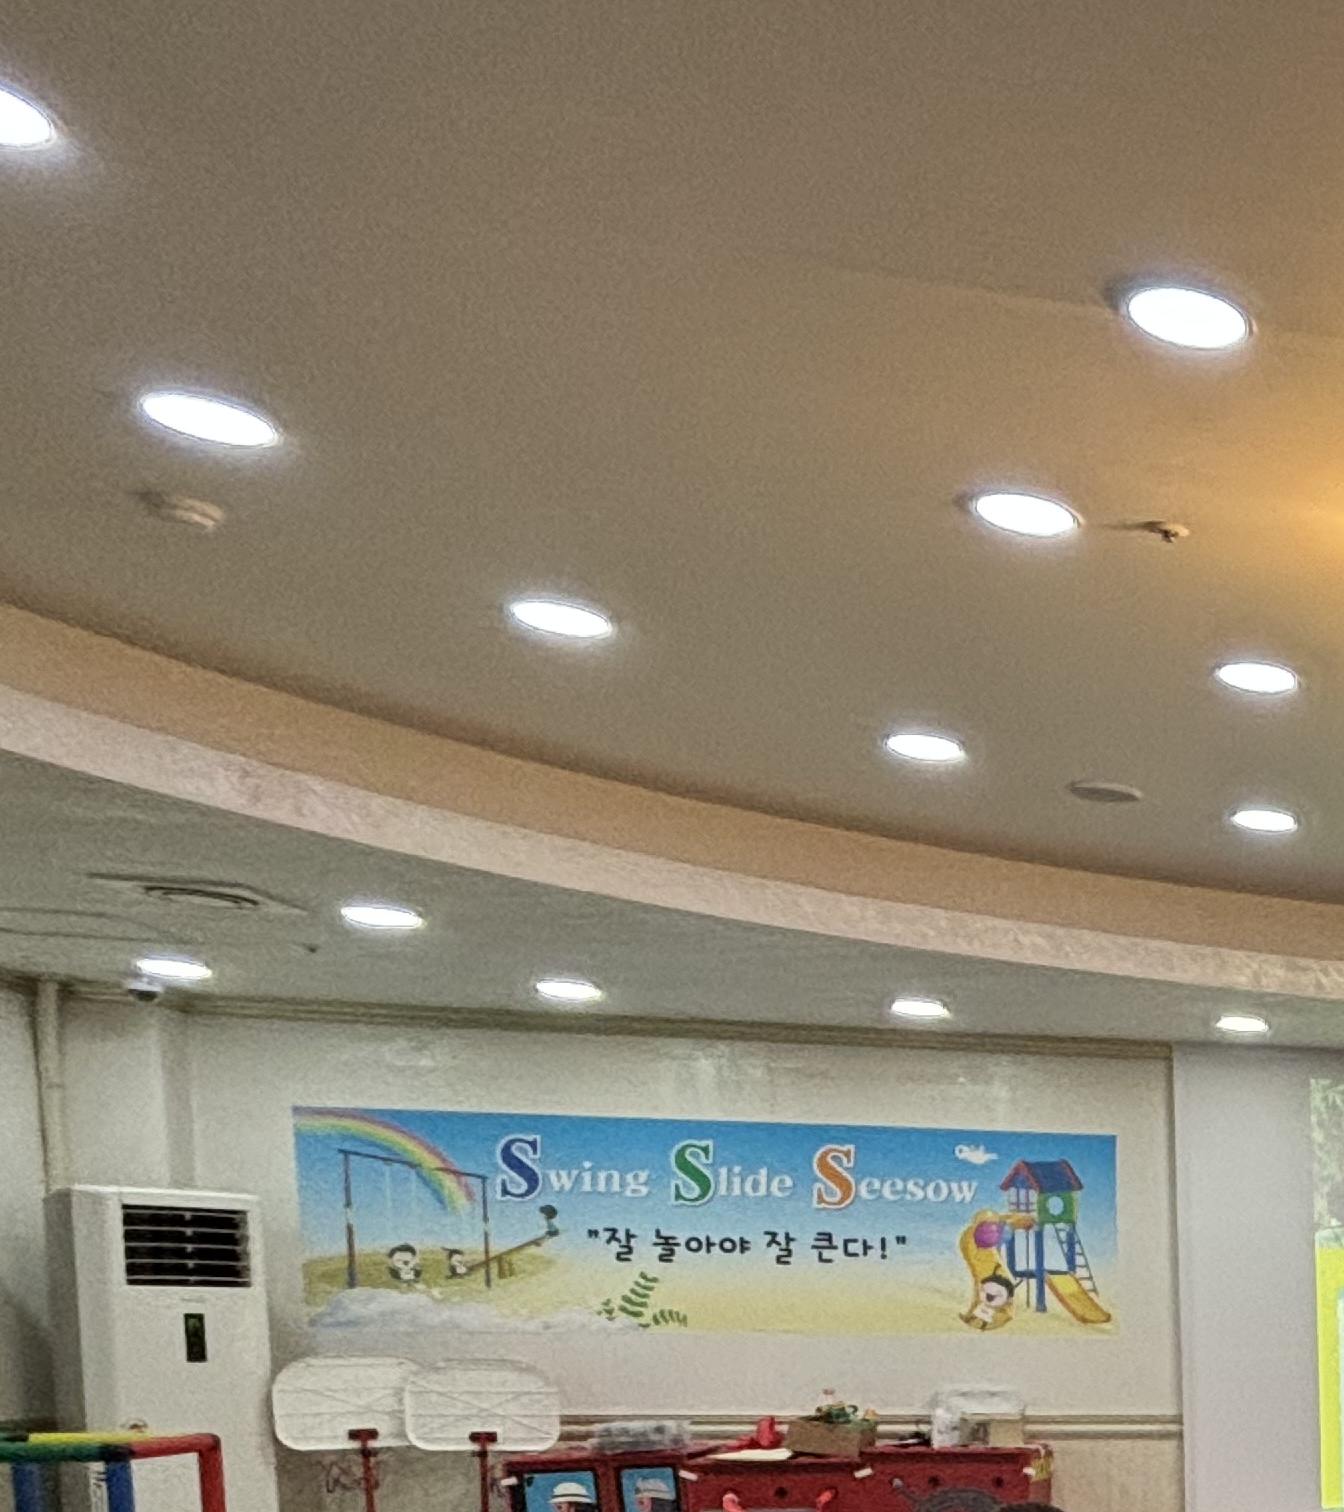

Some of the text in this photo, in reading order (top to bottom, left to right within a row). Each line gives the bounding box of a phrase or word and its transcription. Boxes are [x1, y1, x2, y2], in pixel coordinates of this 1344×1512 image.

[496, 1134, 978, 1209] Swing Slide Seesow
[587, 1227, 907, 1266] "잘 놀아야 잘 큰다!"
